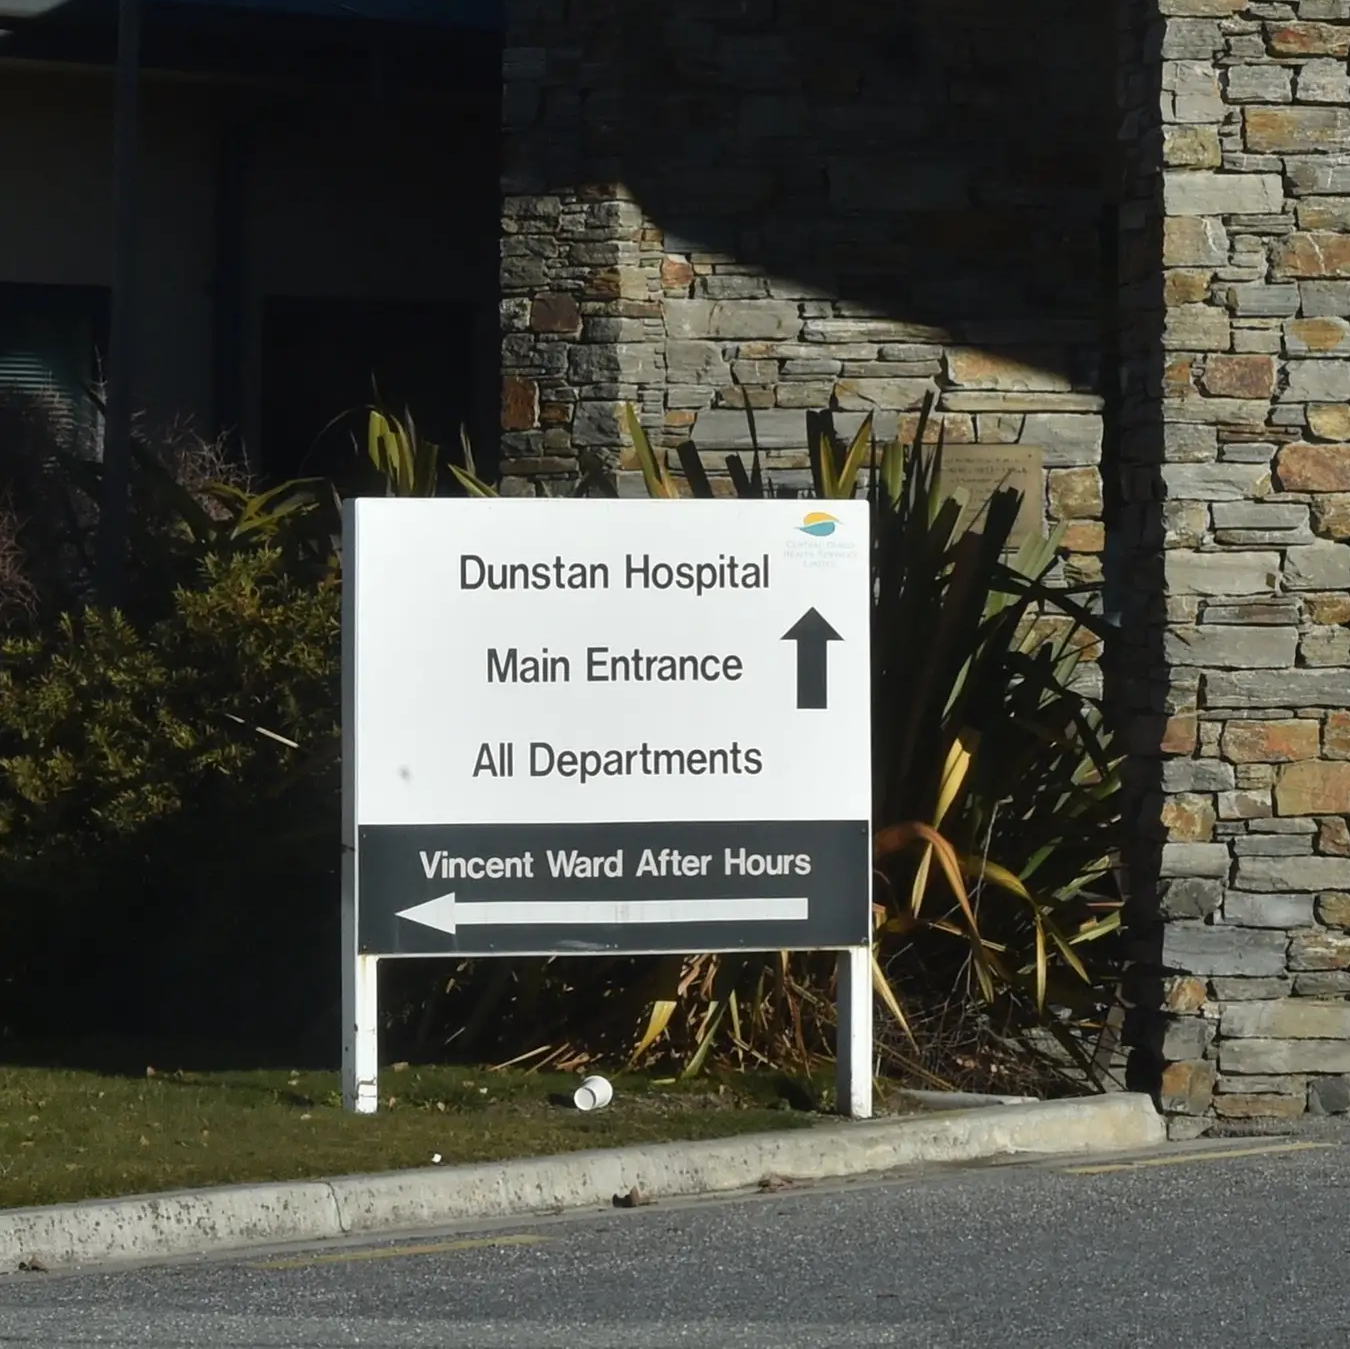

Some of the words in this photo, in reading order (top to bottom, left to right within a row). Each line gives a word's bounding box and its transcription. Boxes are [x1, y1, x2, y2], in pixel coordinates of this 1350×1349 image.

[460, 554, 609, 591] Dunstan
[625, 553, 769, 597] Hospital
[487, 647, 570, 684] Main
[586, 646, 743, 682] Entrance
[472, 741, 514, 778] All
[529, 741, 763, 784] Departments
[419, 850, 534, 880] Vincent
[546, 849, 623, 879] Ward
[635, 848, 713, 877] After
[724, 847, 812, 876] Hours
